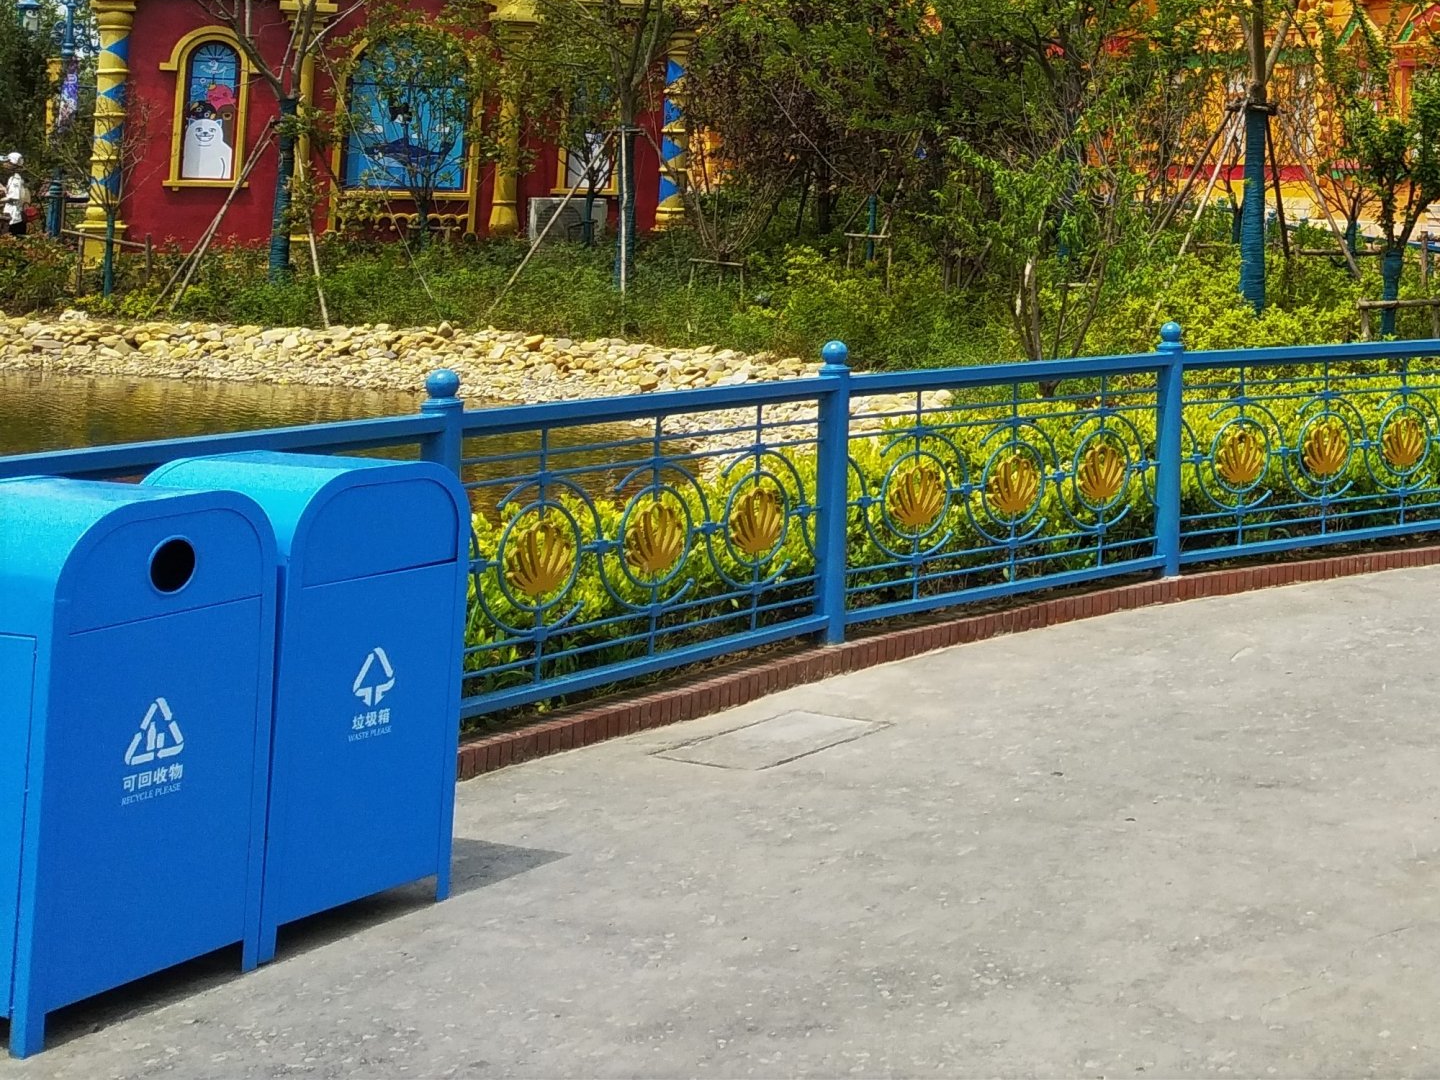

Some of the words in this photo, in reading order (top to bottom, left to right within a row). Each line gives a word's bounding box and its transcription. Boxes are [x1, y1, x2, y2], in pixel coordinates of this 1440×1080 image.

[352, 708, 390, 730] 垃圾箱
[348, 731, 369, 742] WASTE
[370, 725, 392, 737] PLEASE
[122, 763, 184, 792] 可回收物
[121, 789, 153, 806] RECYCLE
[154, 782, 181, 797] PLEASE
